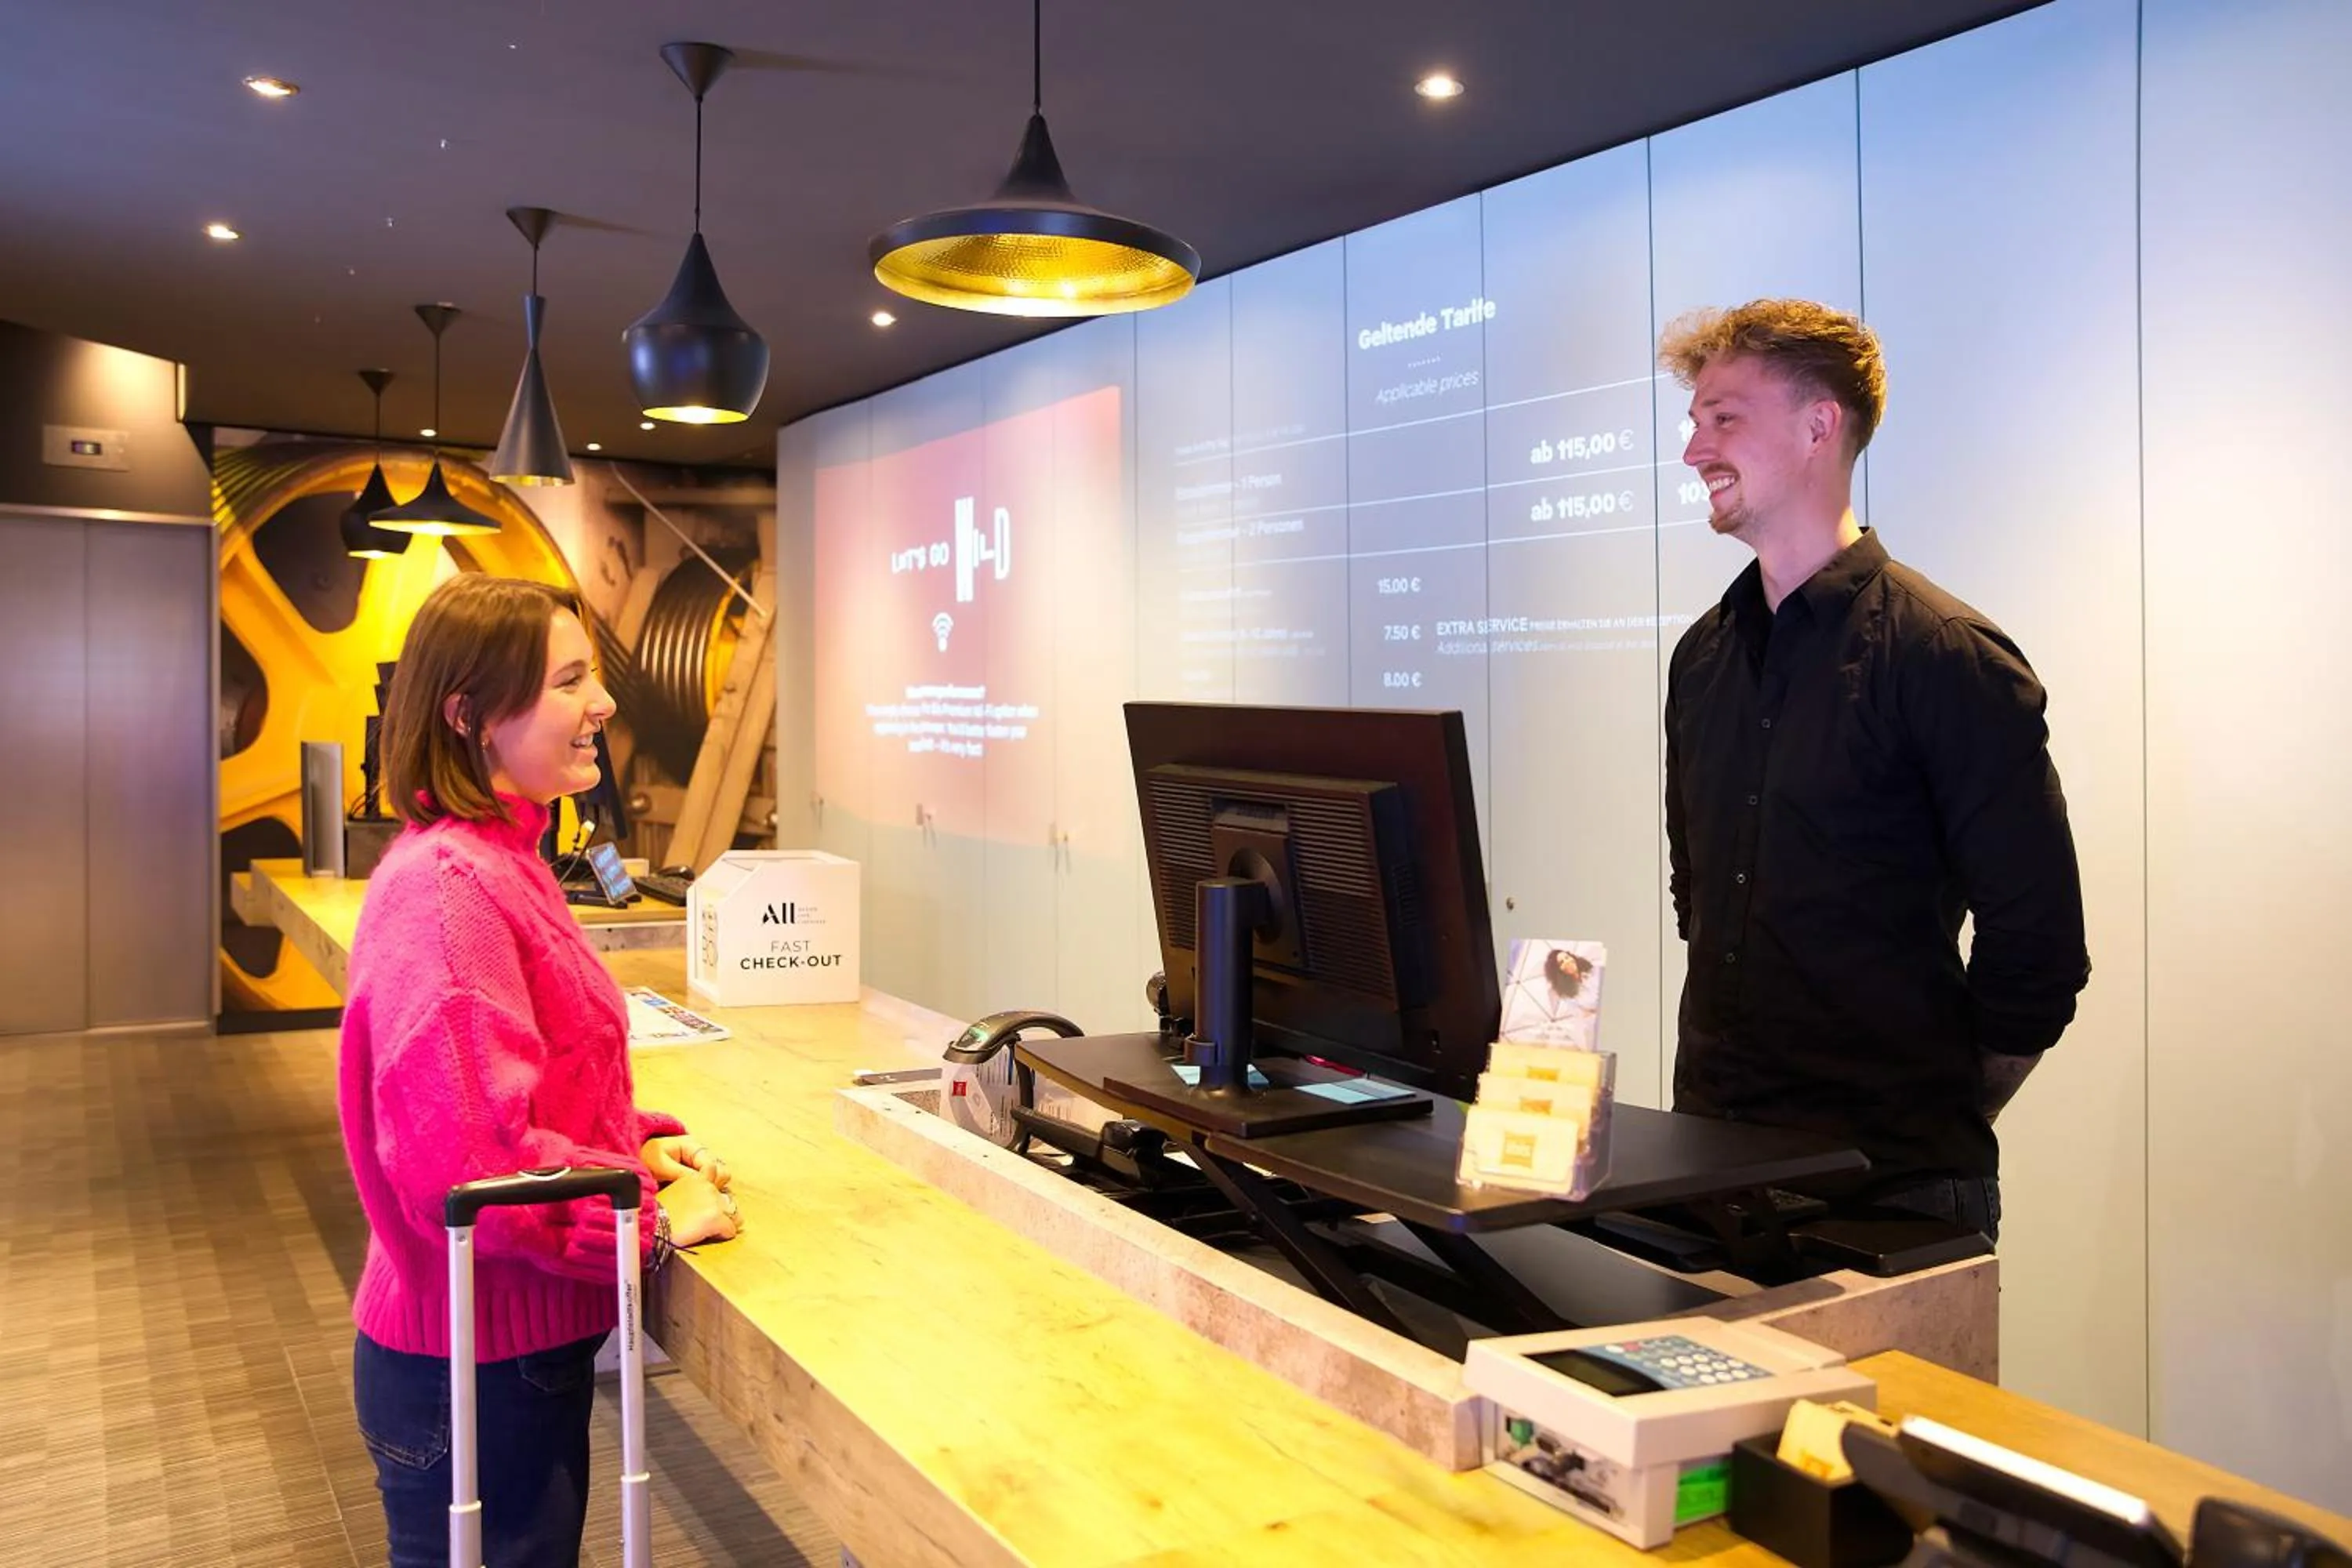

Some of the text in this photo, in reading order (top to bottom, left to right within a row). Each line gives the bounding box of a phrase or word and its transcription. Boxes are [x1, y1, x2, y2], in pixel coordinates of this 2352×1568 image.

[1358, 297, 1496, 350] Geltende Tarife
[1376, 370, 1479, 404] Applicable prices
[1530, 440, 1553, 464] ab
[1557, 432, 1615, 460] 115,00
[1530, 497, 1553, 521] ab
[1557, 493, 1615, 519] 115,00
[1436, 620, 1475, 636] EXTRA
[1476, 616, 1528, 635] SERVICE
[770, 940, 811, 953] FAST
[739, 954, 841, 970] CHECK-OUT
